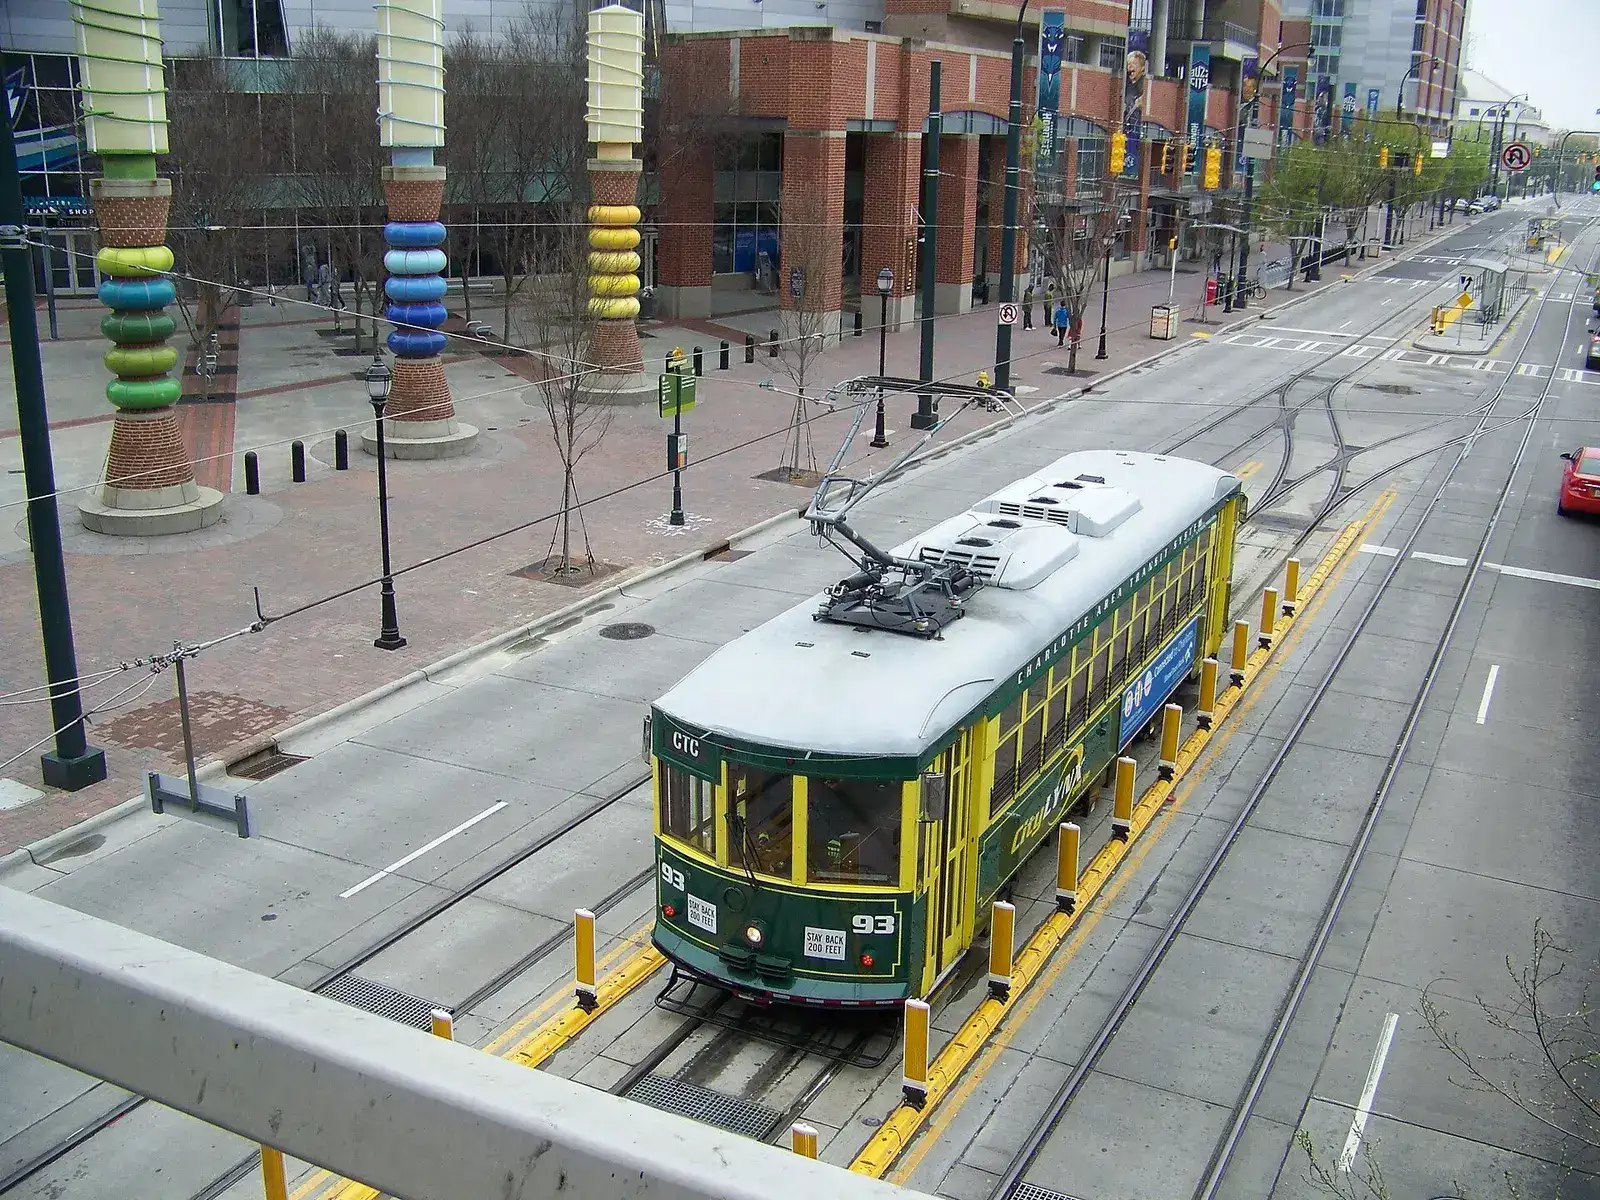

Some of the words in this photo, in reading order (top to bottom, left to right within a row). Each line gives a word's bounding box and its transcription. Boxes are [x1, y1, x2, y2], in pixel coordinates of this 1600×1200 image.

[1017, 616, 1089, 685] CHARLOTTE
[1096, 587, 1122, 616] AREA
[1129, 547, 1168, 588] TRANSIT
[1173, 518, 1203, 550] SYSTEM
[673, 731, 699, 757] CTC
[661, 861, 684, 892] 93
[689, 899, 701, 913] STAY
[701, 905, 715, 918] BACK
[690, 909, 701, 922] 200
[702, 915, 714, 927] FEET
[852, 914, 895, 934] 93
[807, 932, 823, 943] STAY
[825, 935, 844, 945] BACK
[808, 943, 823, 953] 200
[825, 945, 841, 955] FEET
